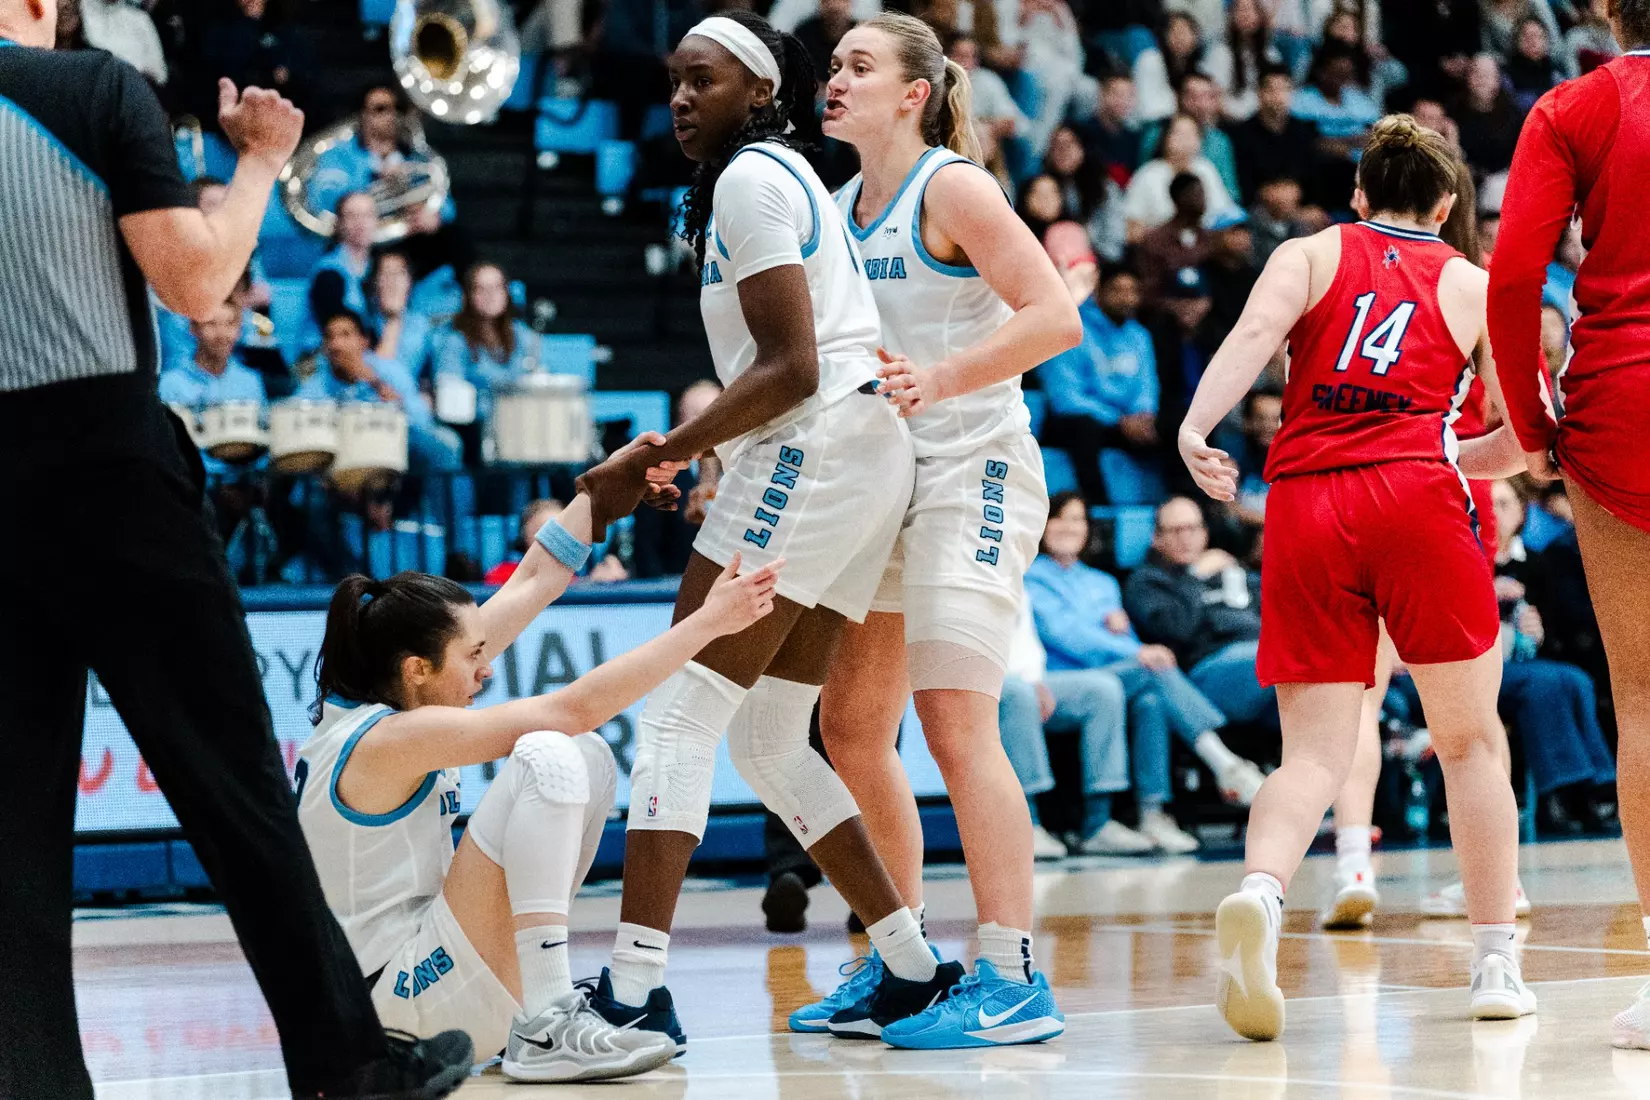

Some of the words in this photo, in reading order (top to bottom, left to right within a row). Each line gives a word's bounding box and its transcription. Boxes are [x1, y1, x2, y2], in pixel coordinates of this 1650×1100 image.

[1334, 291, 1417, 377] 14
[743, 445, 804, 549] LIONS
[976, 459, 1008, 566] LIONS
